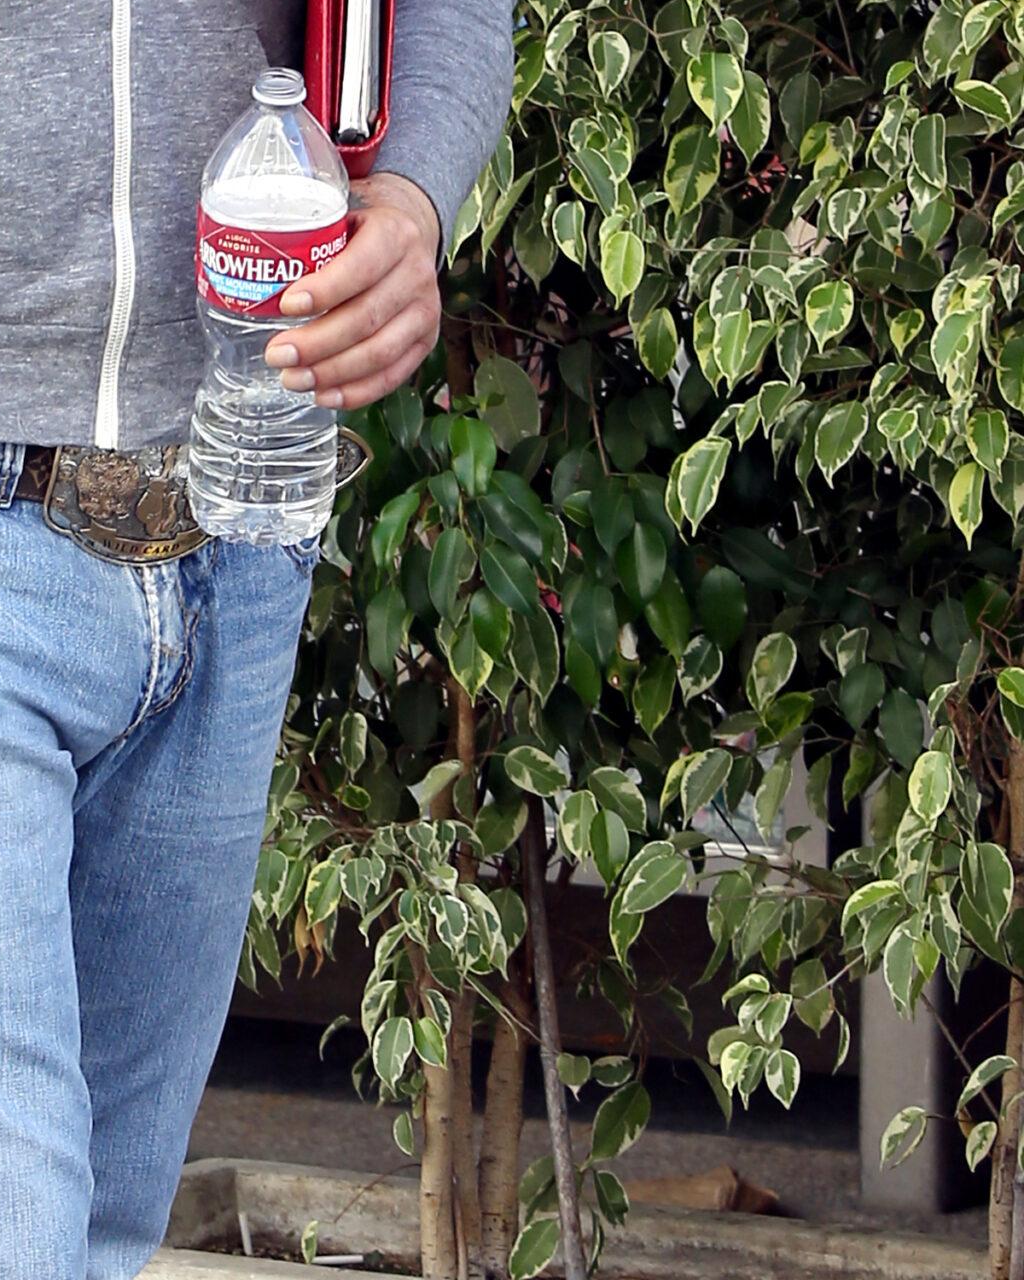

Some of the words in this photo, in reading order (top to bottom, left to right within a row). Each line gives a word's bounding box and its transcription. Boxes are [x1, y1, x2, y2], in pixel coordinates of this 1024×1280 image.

[218, 238, 261, 254] FAVORITE
[231, 234, 251, 244] LOCAL
[226, 278, 273, 293] MOUNTAIN
[103, 539, 139, 554] WILD
[143, 543, 180, 554] CARD
